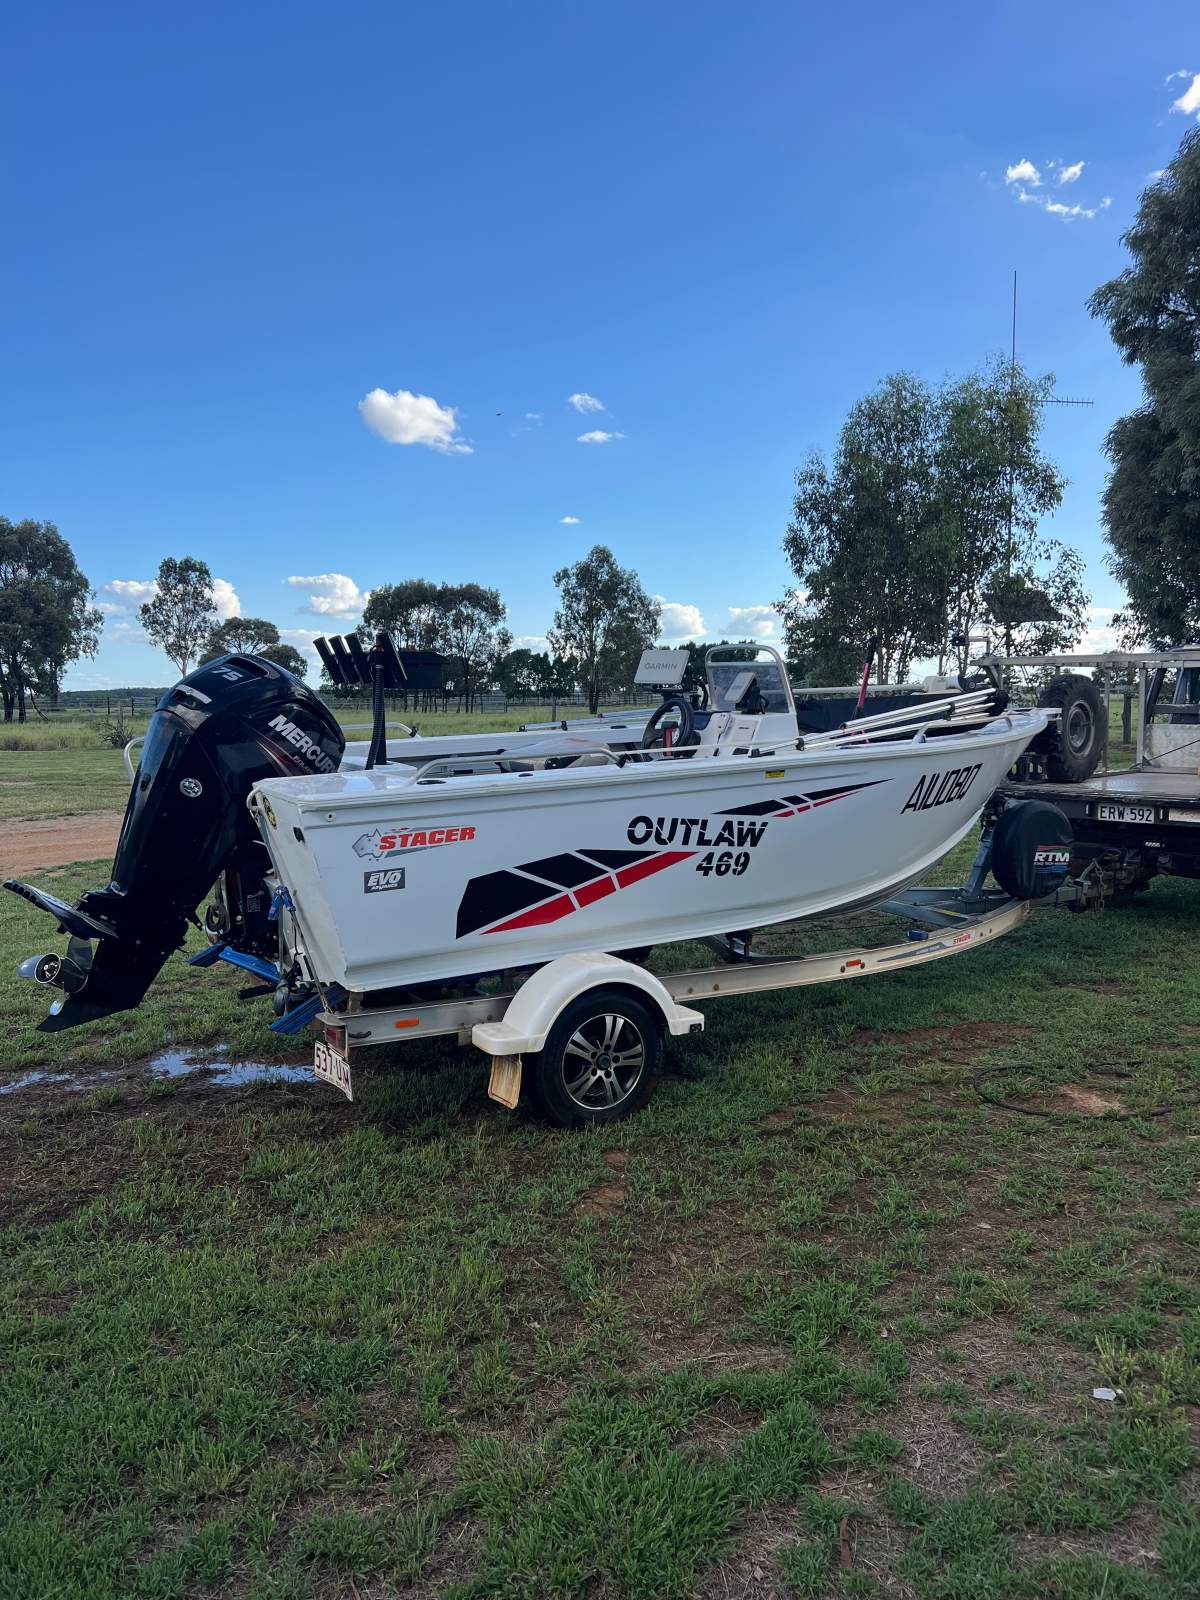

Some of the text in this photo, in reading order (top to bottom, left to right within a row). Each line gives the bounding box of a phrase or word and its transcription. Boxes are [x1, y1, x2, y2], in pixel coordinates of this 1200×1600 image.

[212, 666, 244, 682] 75
[644, 662, 678, 671] GARMIN
[267, 714, 336, 774] MERCUR
[379, 827, 476, 850] STACER
[627, 815, 769, 847] OUTLAW
[696, 851, 750, 876] 469
[1034, 852, 1070, 862] RTM
[367, 869, 402, 887] EVO
